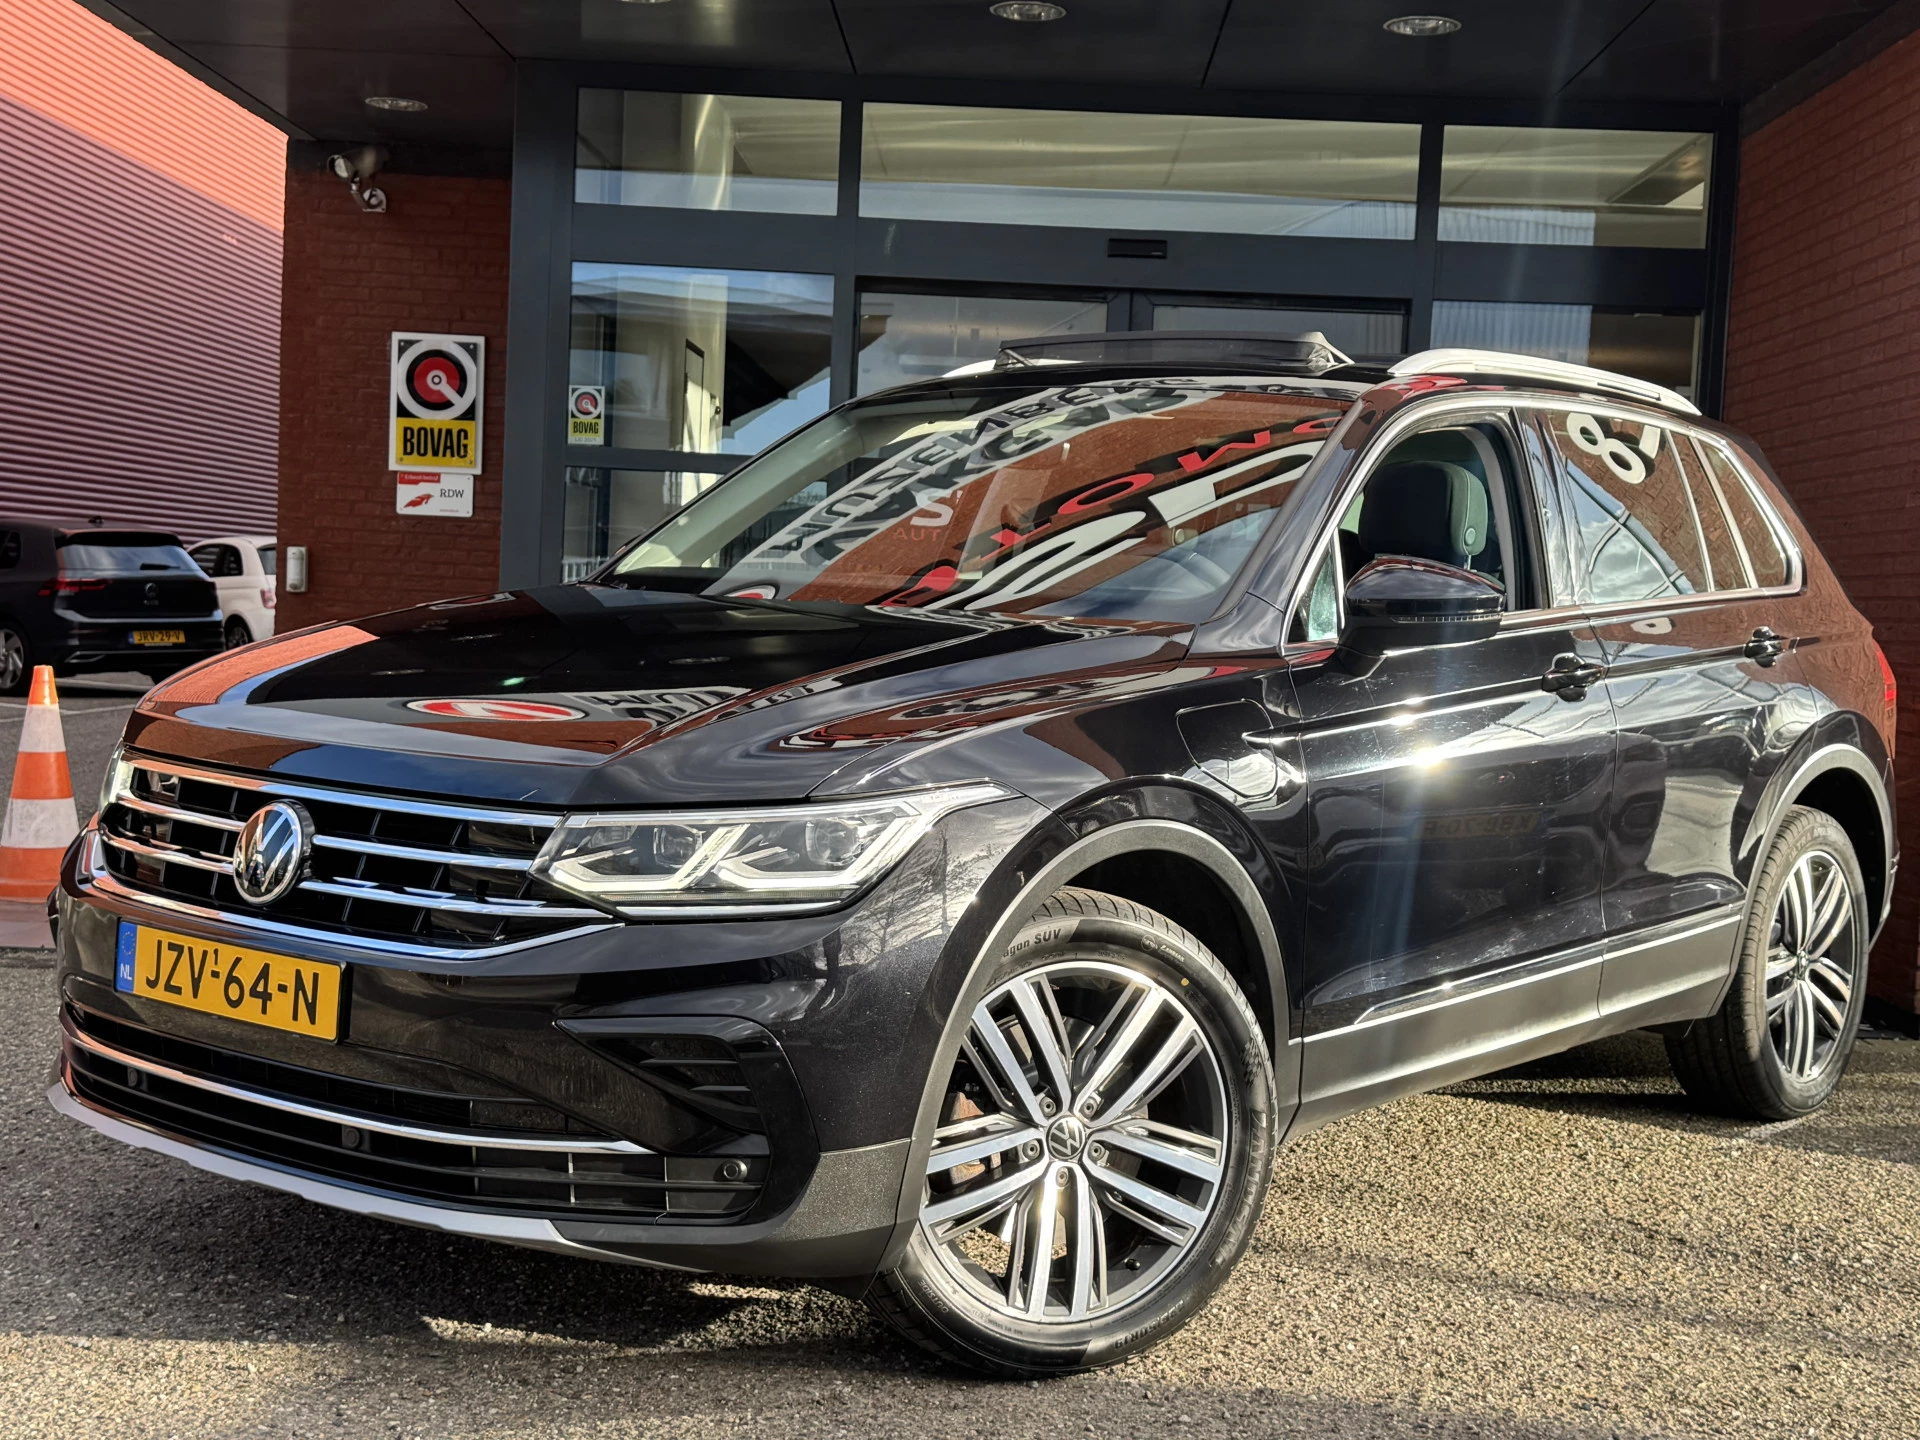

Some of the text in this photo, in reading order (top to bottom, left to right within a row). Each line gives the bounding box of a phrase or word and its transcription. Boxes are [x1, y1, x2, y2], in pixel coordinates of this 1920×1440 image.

[573, 421, 599, 434] BOVAG
[402, 426, 469, 460] BOVAG
[440, 488, 464, 498] RDW
[1034, 928, 1062, 944] SUV
[120, 963, 133, 981] NL
[917, 1280, 949, 1314] OUTSIDE
